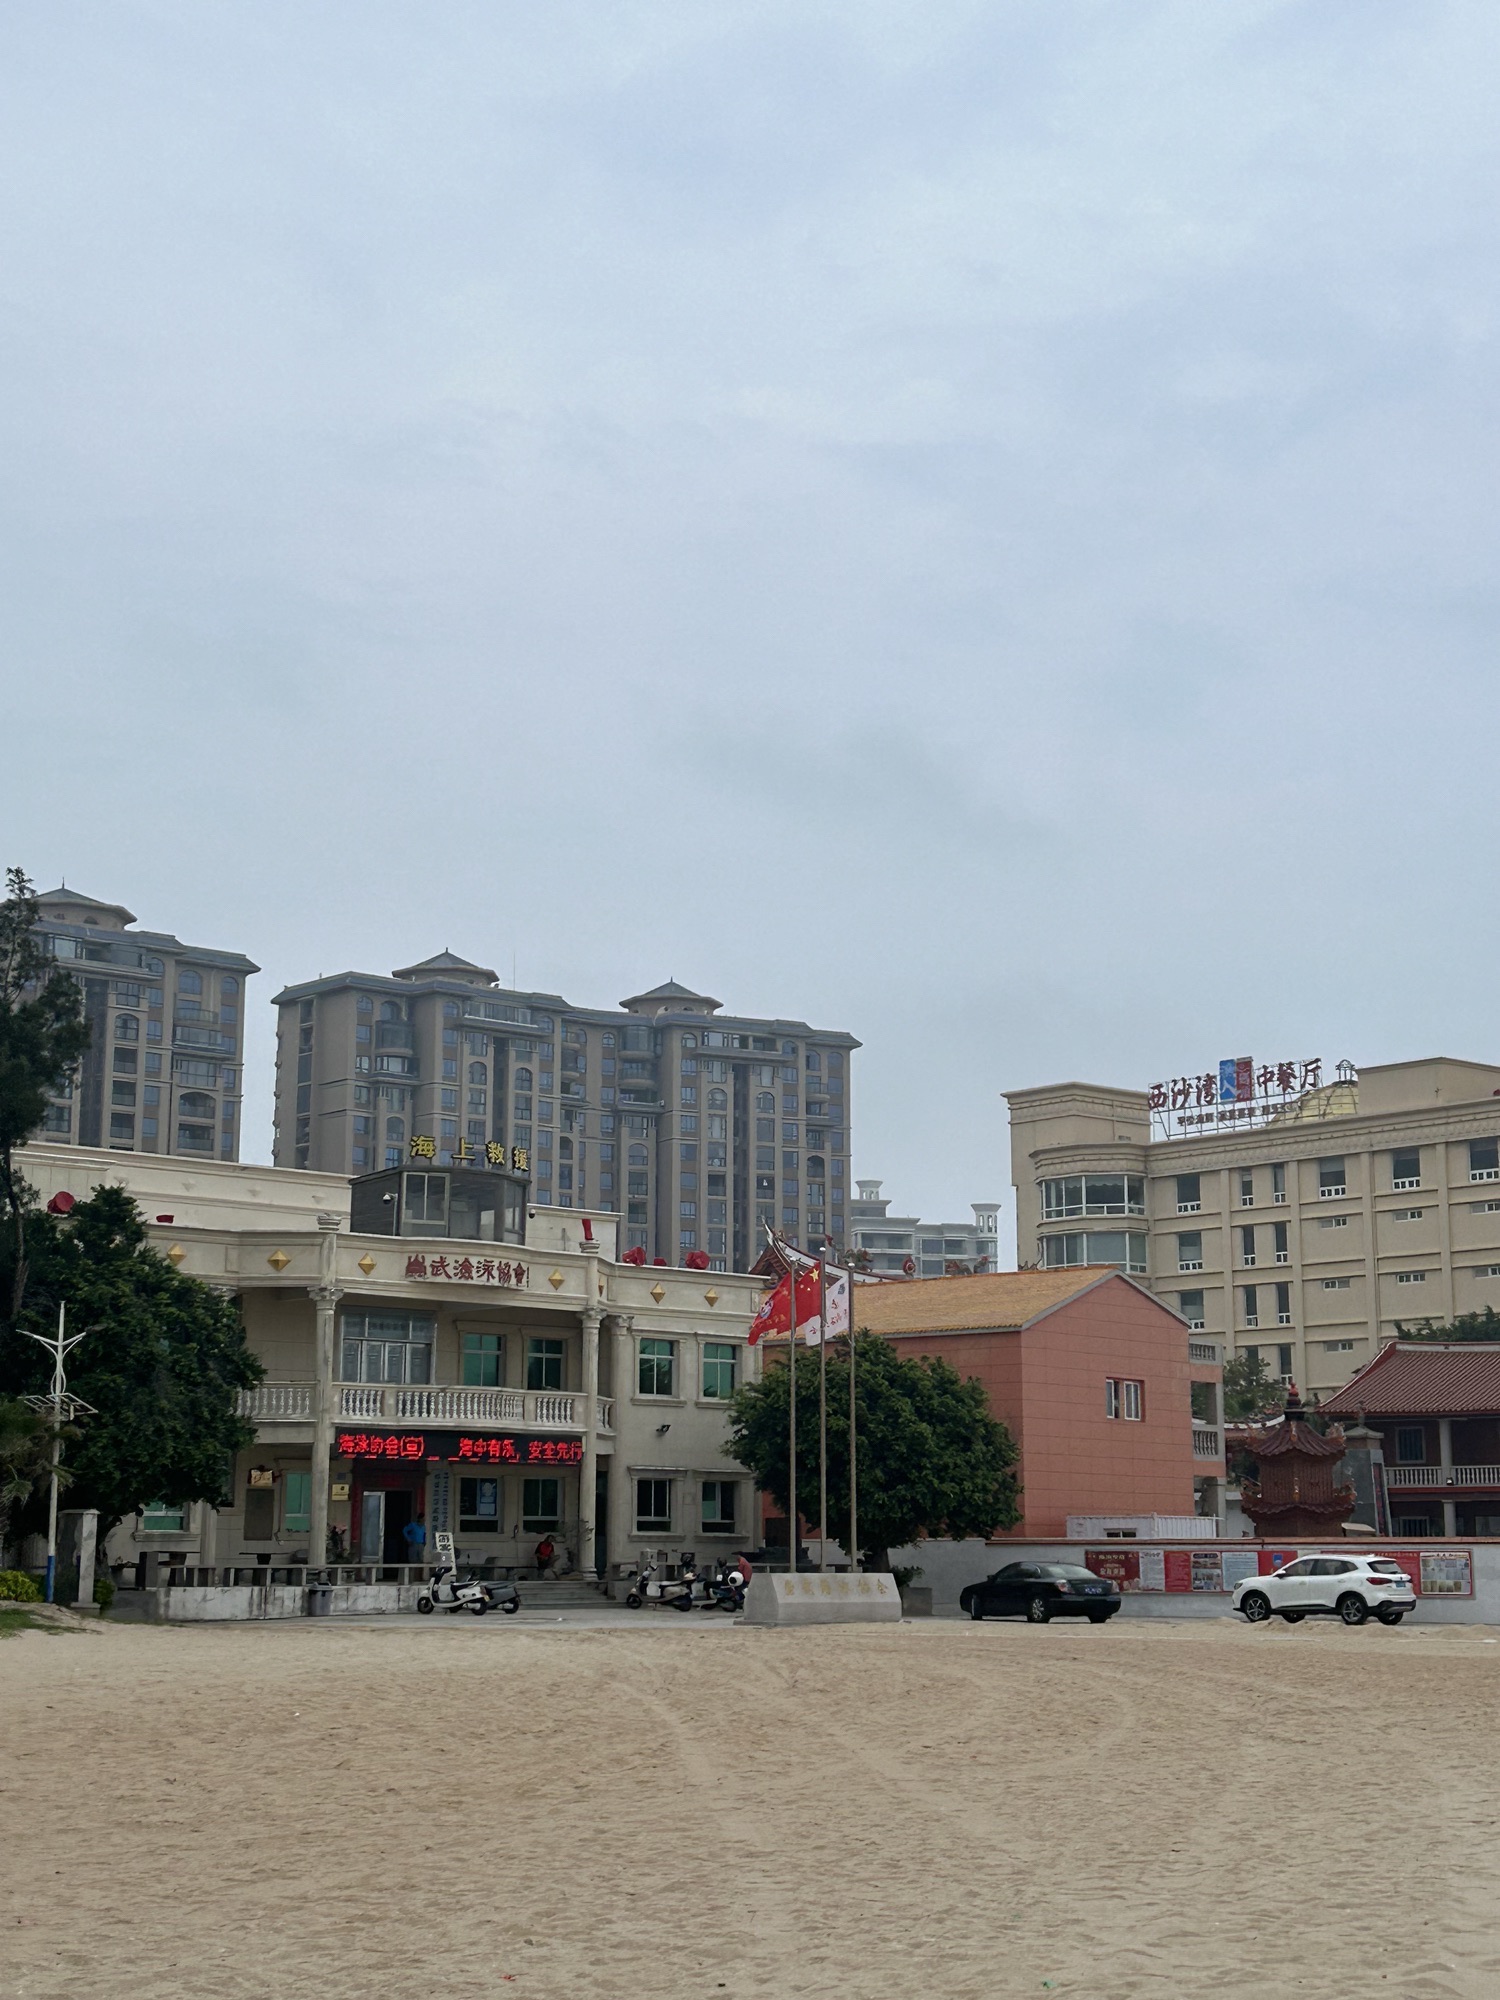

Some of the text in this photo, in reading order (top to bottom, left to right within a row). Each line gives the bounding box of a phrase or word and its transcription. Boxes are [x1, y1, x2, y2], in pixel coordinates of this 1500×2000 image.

[1148, 1073, 1217, 1109] 西沙湾
[1256, 1057, 1322, 1096] 中餐厅
[409, 1135, 529, 1171] 海上救援
